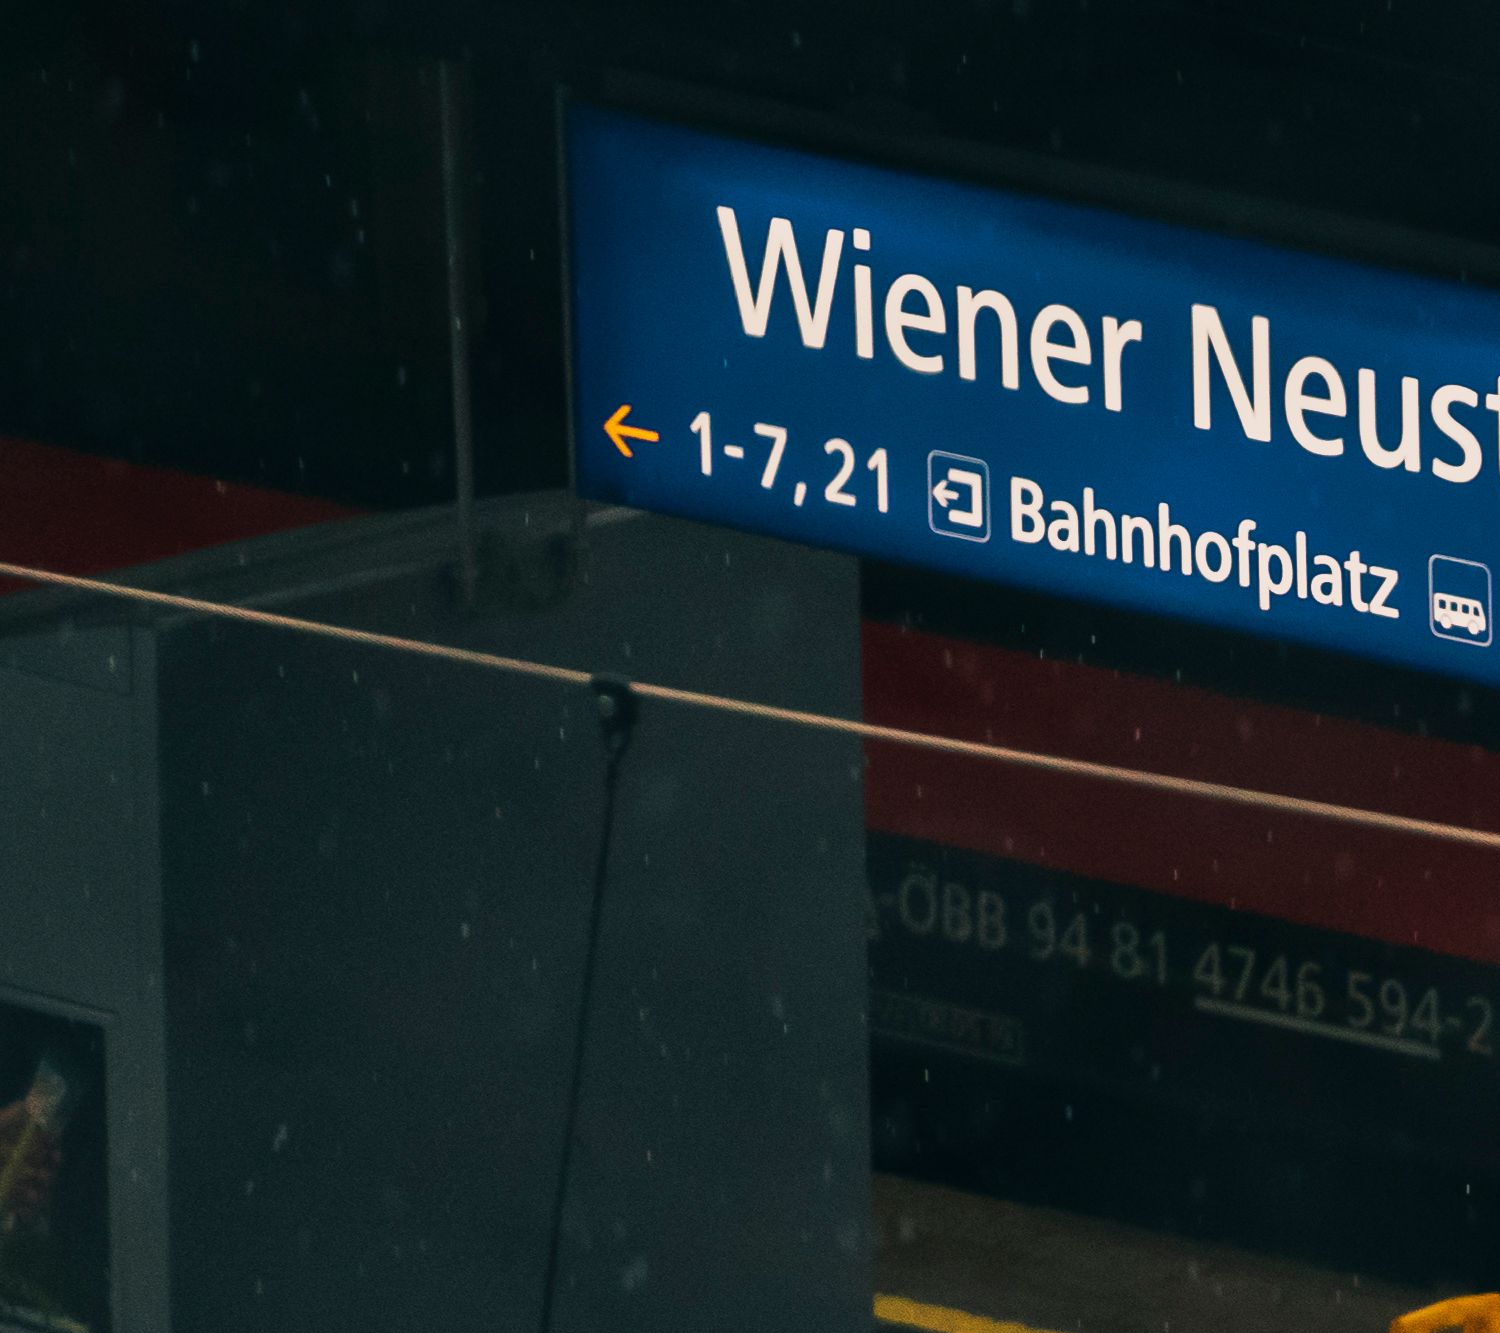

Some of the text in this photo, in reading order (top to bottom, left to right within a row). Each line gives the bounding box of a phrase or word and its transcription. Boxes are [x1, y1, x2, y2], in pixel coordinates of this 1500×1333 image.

[715, 203, 1144, 412] Wiener
[689, 411, 889, 514] 1-7,21
[1010, 477, 1400, 621] Bahnhofplatz
[1026, 903, 1090, 968] 94
[1111, 920, 1169, 982] 81
[1194, 940, 1326, 1019] 4746
[1347, 969, 1493, 1054] 594-2
